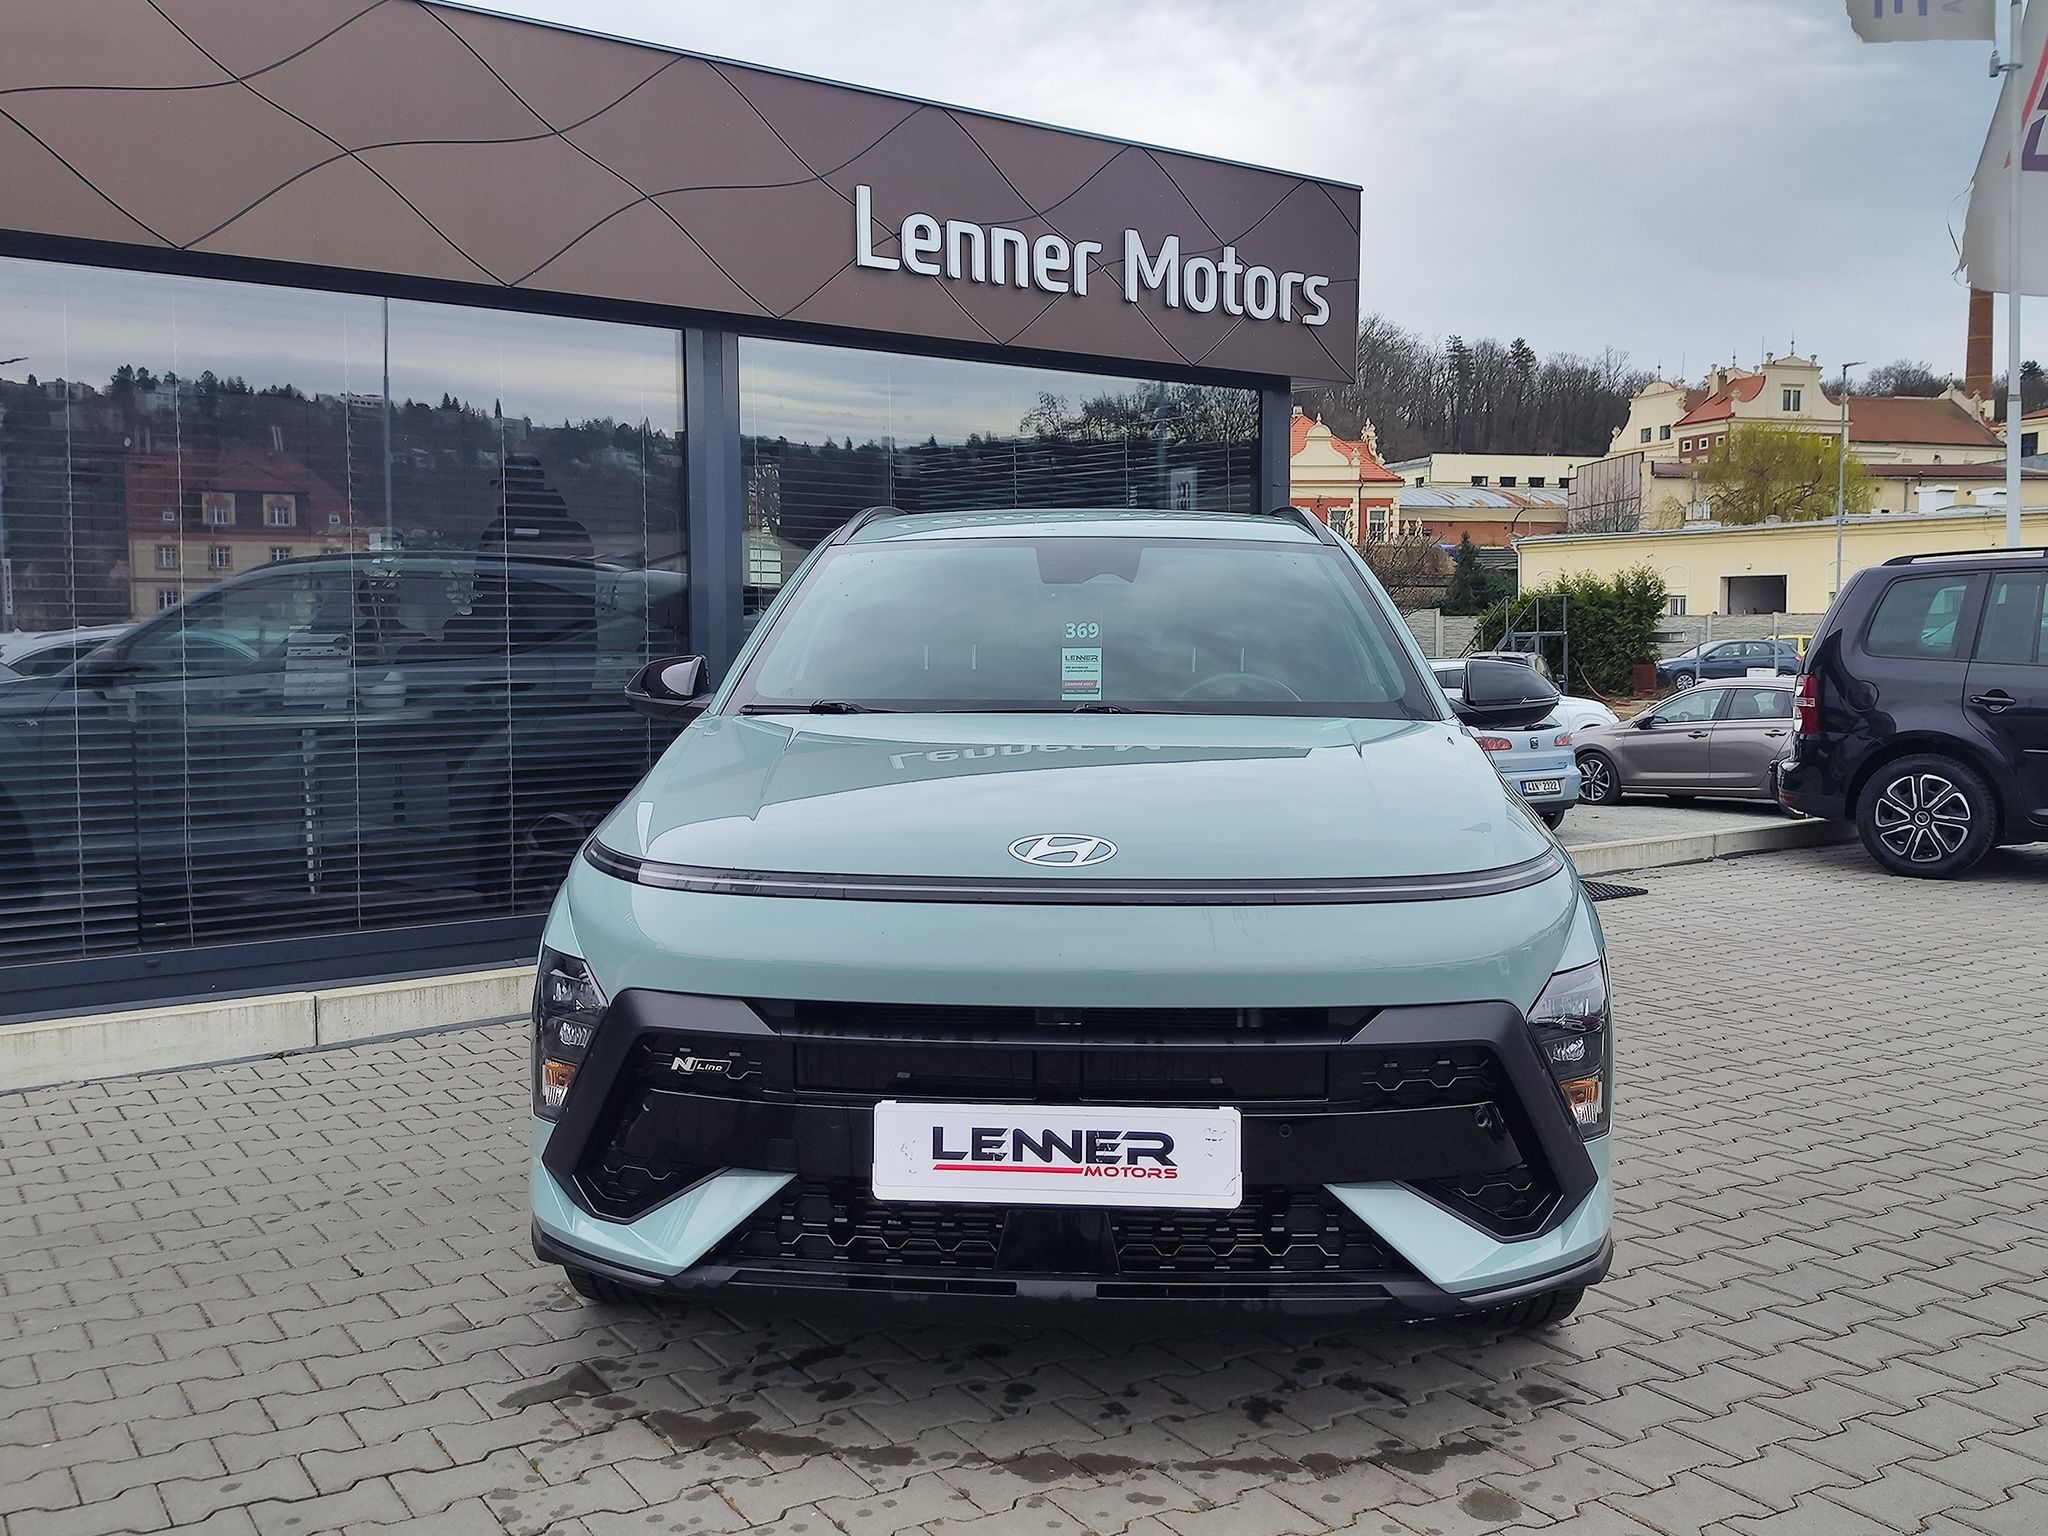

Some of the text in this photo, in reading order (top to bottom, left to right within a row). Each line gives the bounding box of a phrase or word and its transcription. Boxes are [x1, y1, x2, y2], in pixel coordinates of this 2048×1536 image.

[855, 184, 1330, 326] Lenner Motors
[1065, 622, 1099, 639] 369
[932, 1126, 1178, 1167] LENNER
[1084, 1166, 1178, 1179] MOTORS
